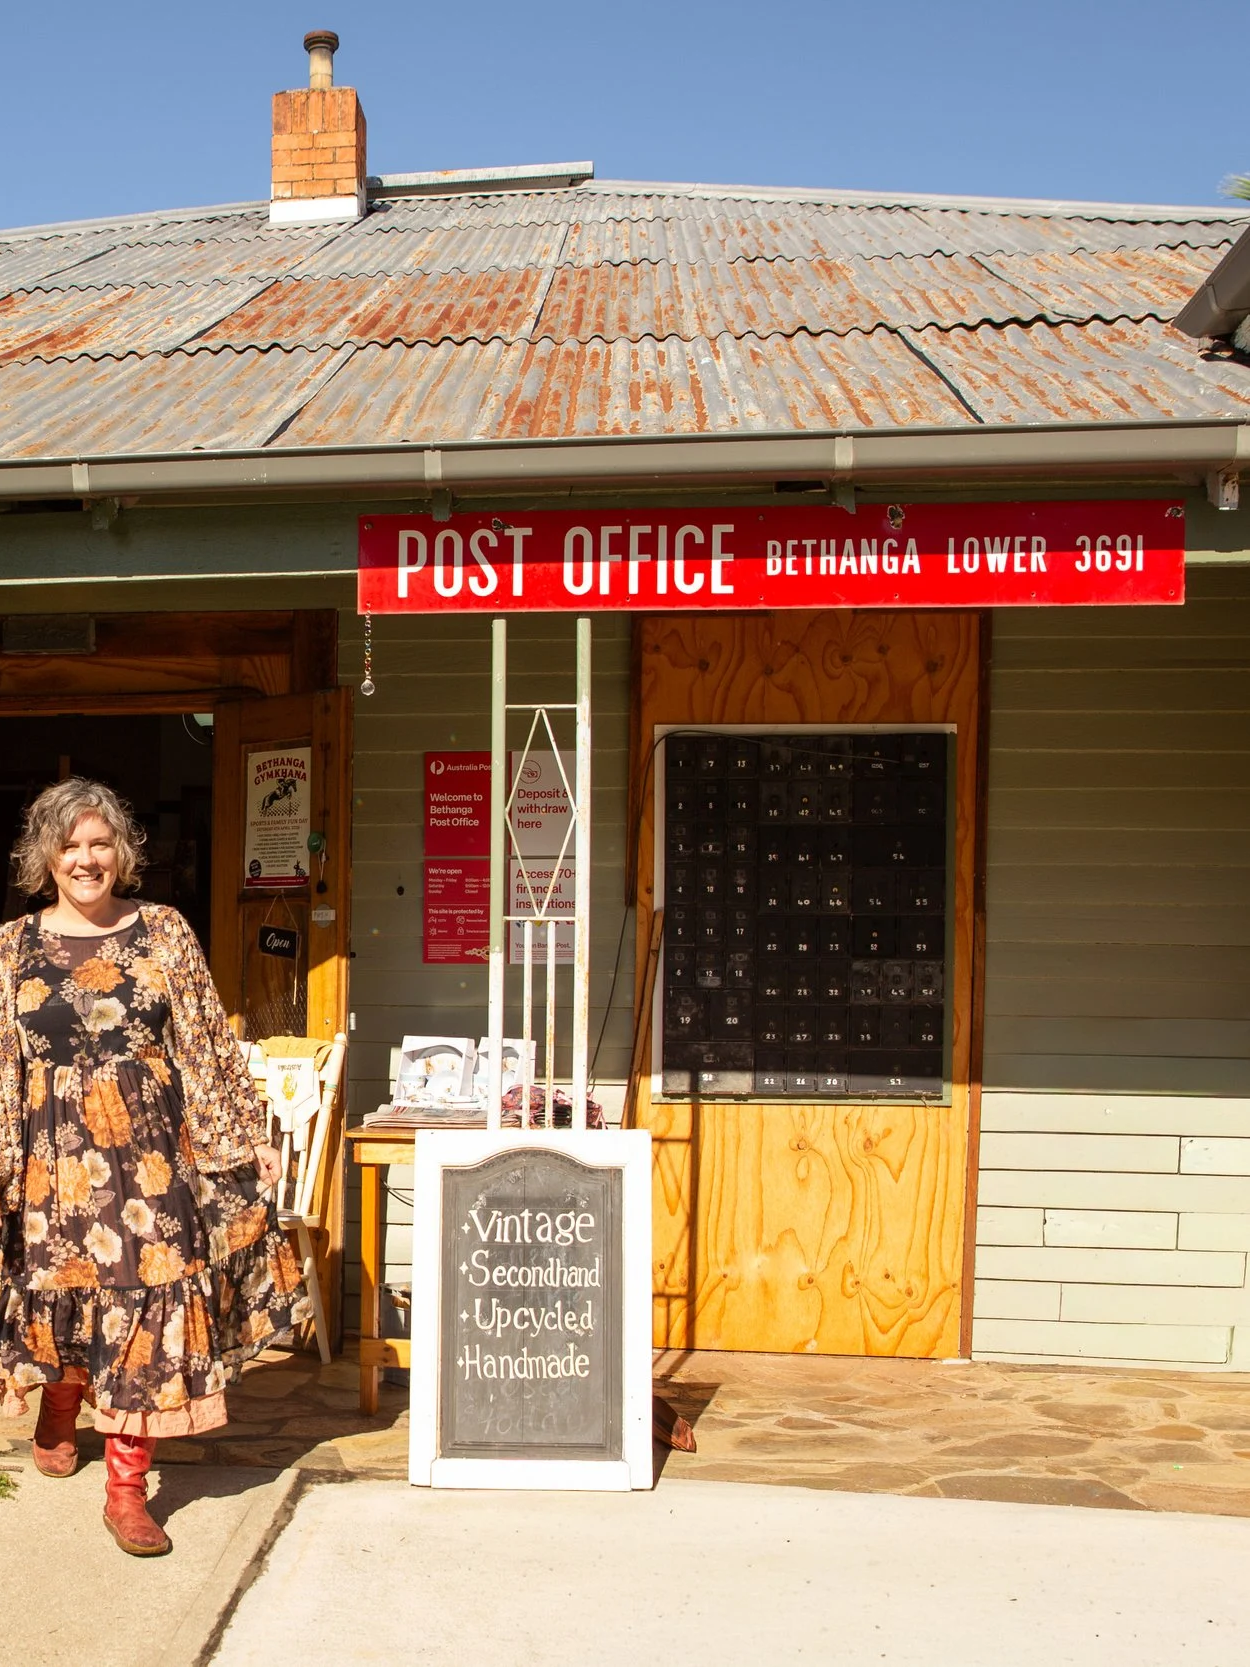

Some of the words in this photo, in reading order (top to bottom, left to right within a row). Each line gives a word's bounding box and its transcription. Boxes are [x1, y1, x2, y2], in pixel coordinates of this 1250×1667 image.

[398, 528, 533, 598] POST
[563, 525, 735, 595] OFFICE
[766, 537, 921, 576] BETHANGA
[948, 536, 1048, 574] LOWER
[1075, 535, 1144, 572] 3691
[256, 758, 305, 773] BETHANGA
[446, 763, 478, 771] Australia
[254, 769, 306, 785] GYMKHANA
[430, 793, 472, 801] Welcome
[473, 793, 483, 801] to
[518, 789, 560, 800] Deposit
[430, 805, 473, 815] Bethanga
[517, 804, 568, 813] withdraw
[430, 818, 450, 826] Post
[451, 818, 479, 826] Office
[518, 819, 542, 828] here
[266, 932, 290, 950] Open
[767, 943, 777, 951] 25
[726, 1017, 738, 1025] 20
[469, 1208, 595, 1246] Vintage
[469, 1250, 601, 1288] Secondhand
[474, 1298, 594, 1337] Upcycled
[464, 1343, 590, 1381] Handmade
